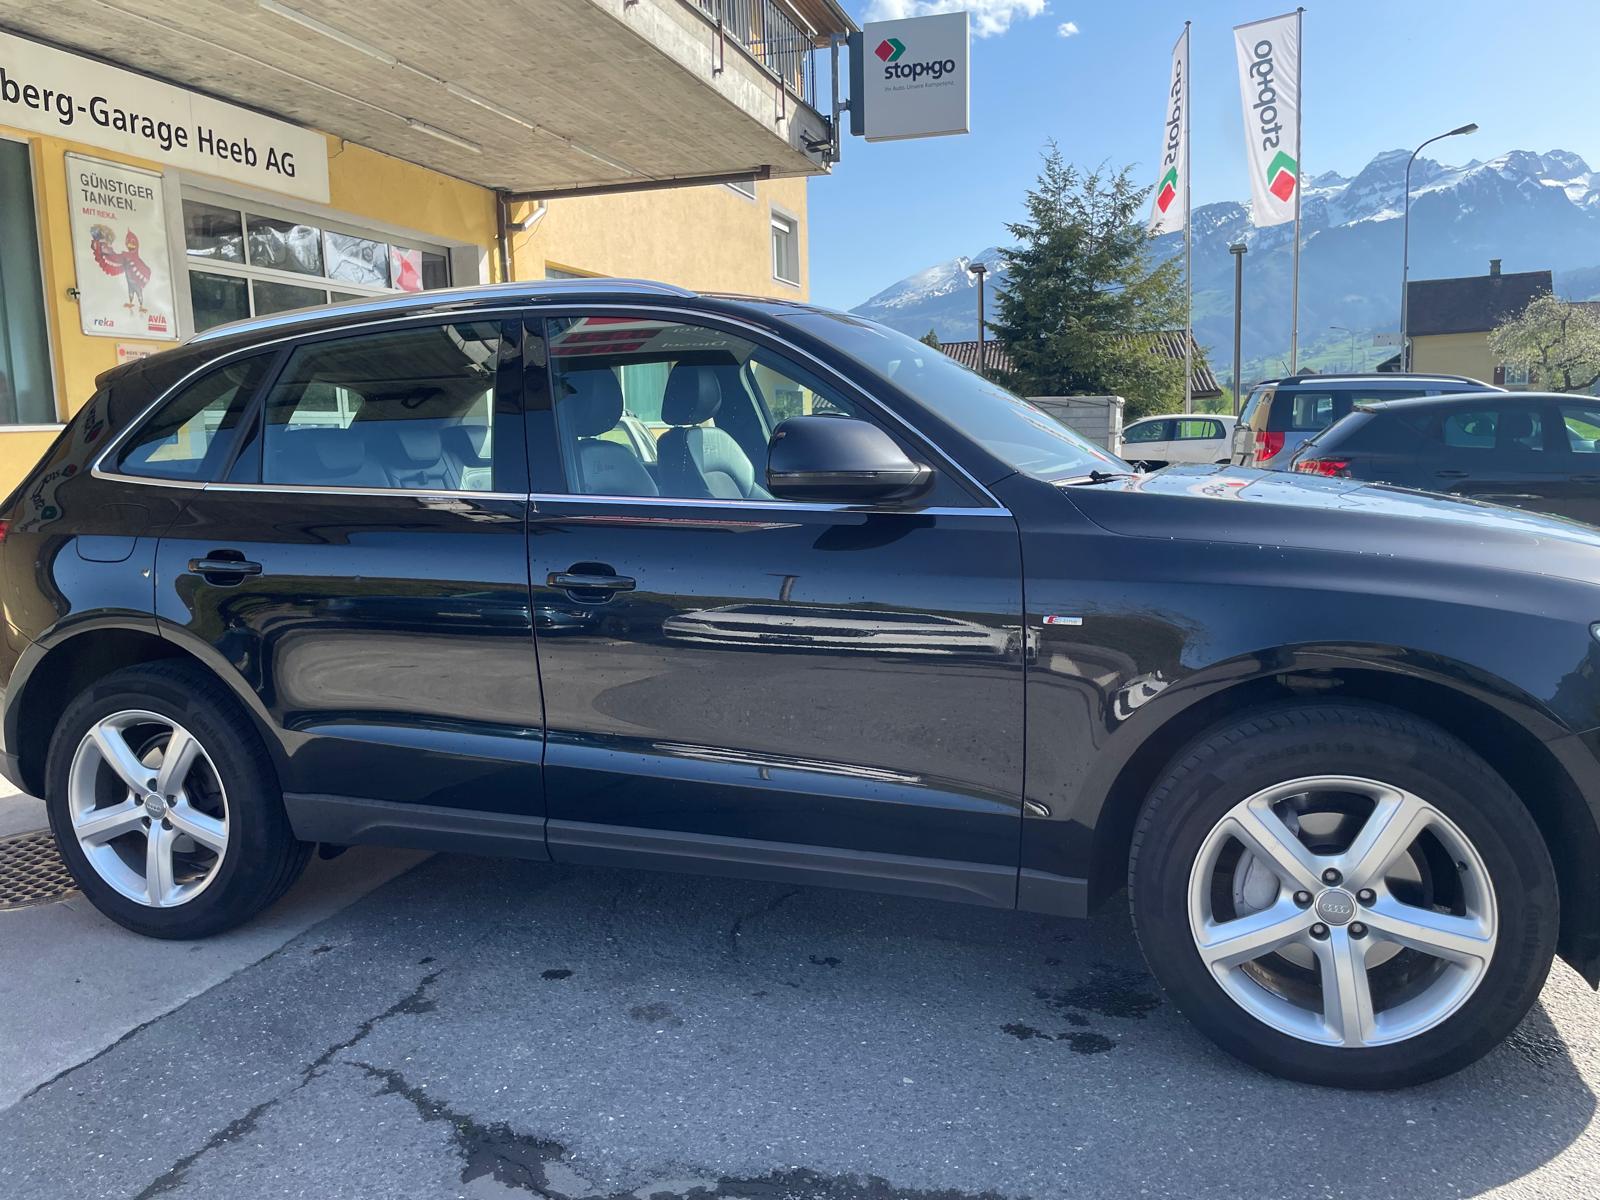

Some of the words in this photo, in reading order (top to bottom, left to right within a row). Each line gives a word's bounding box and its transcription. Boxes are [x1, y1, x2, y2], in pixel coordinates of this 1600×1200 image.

[884, 59, 956, 82] stop+go
[197, 126, 258, 167] Heeb
[266, 147, 297, 178] AG
[80, 172, 154, 201] GÜNSTIGER
[81, 189, 137, 212] TANKEN.
[82, 207, 96, 216] MIT
[94, 317, 114, 328] reka
[148, 313, 167, 324] AVIA
